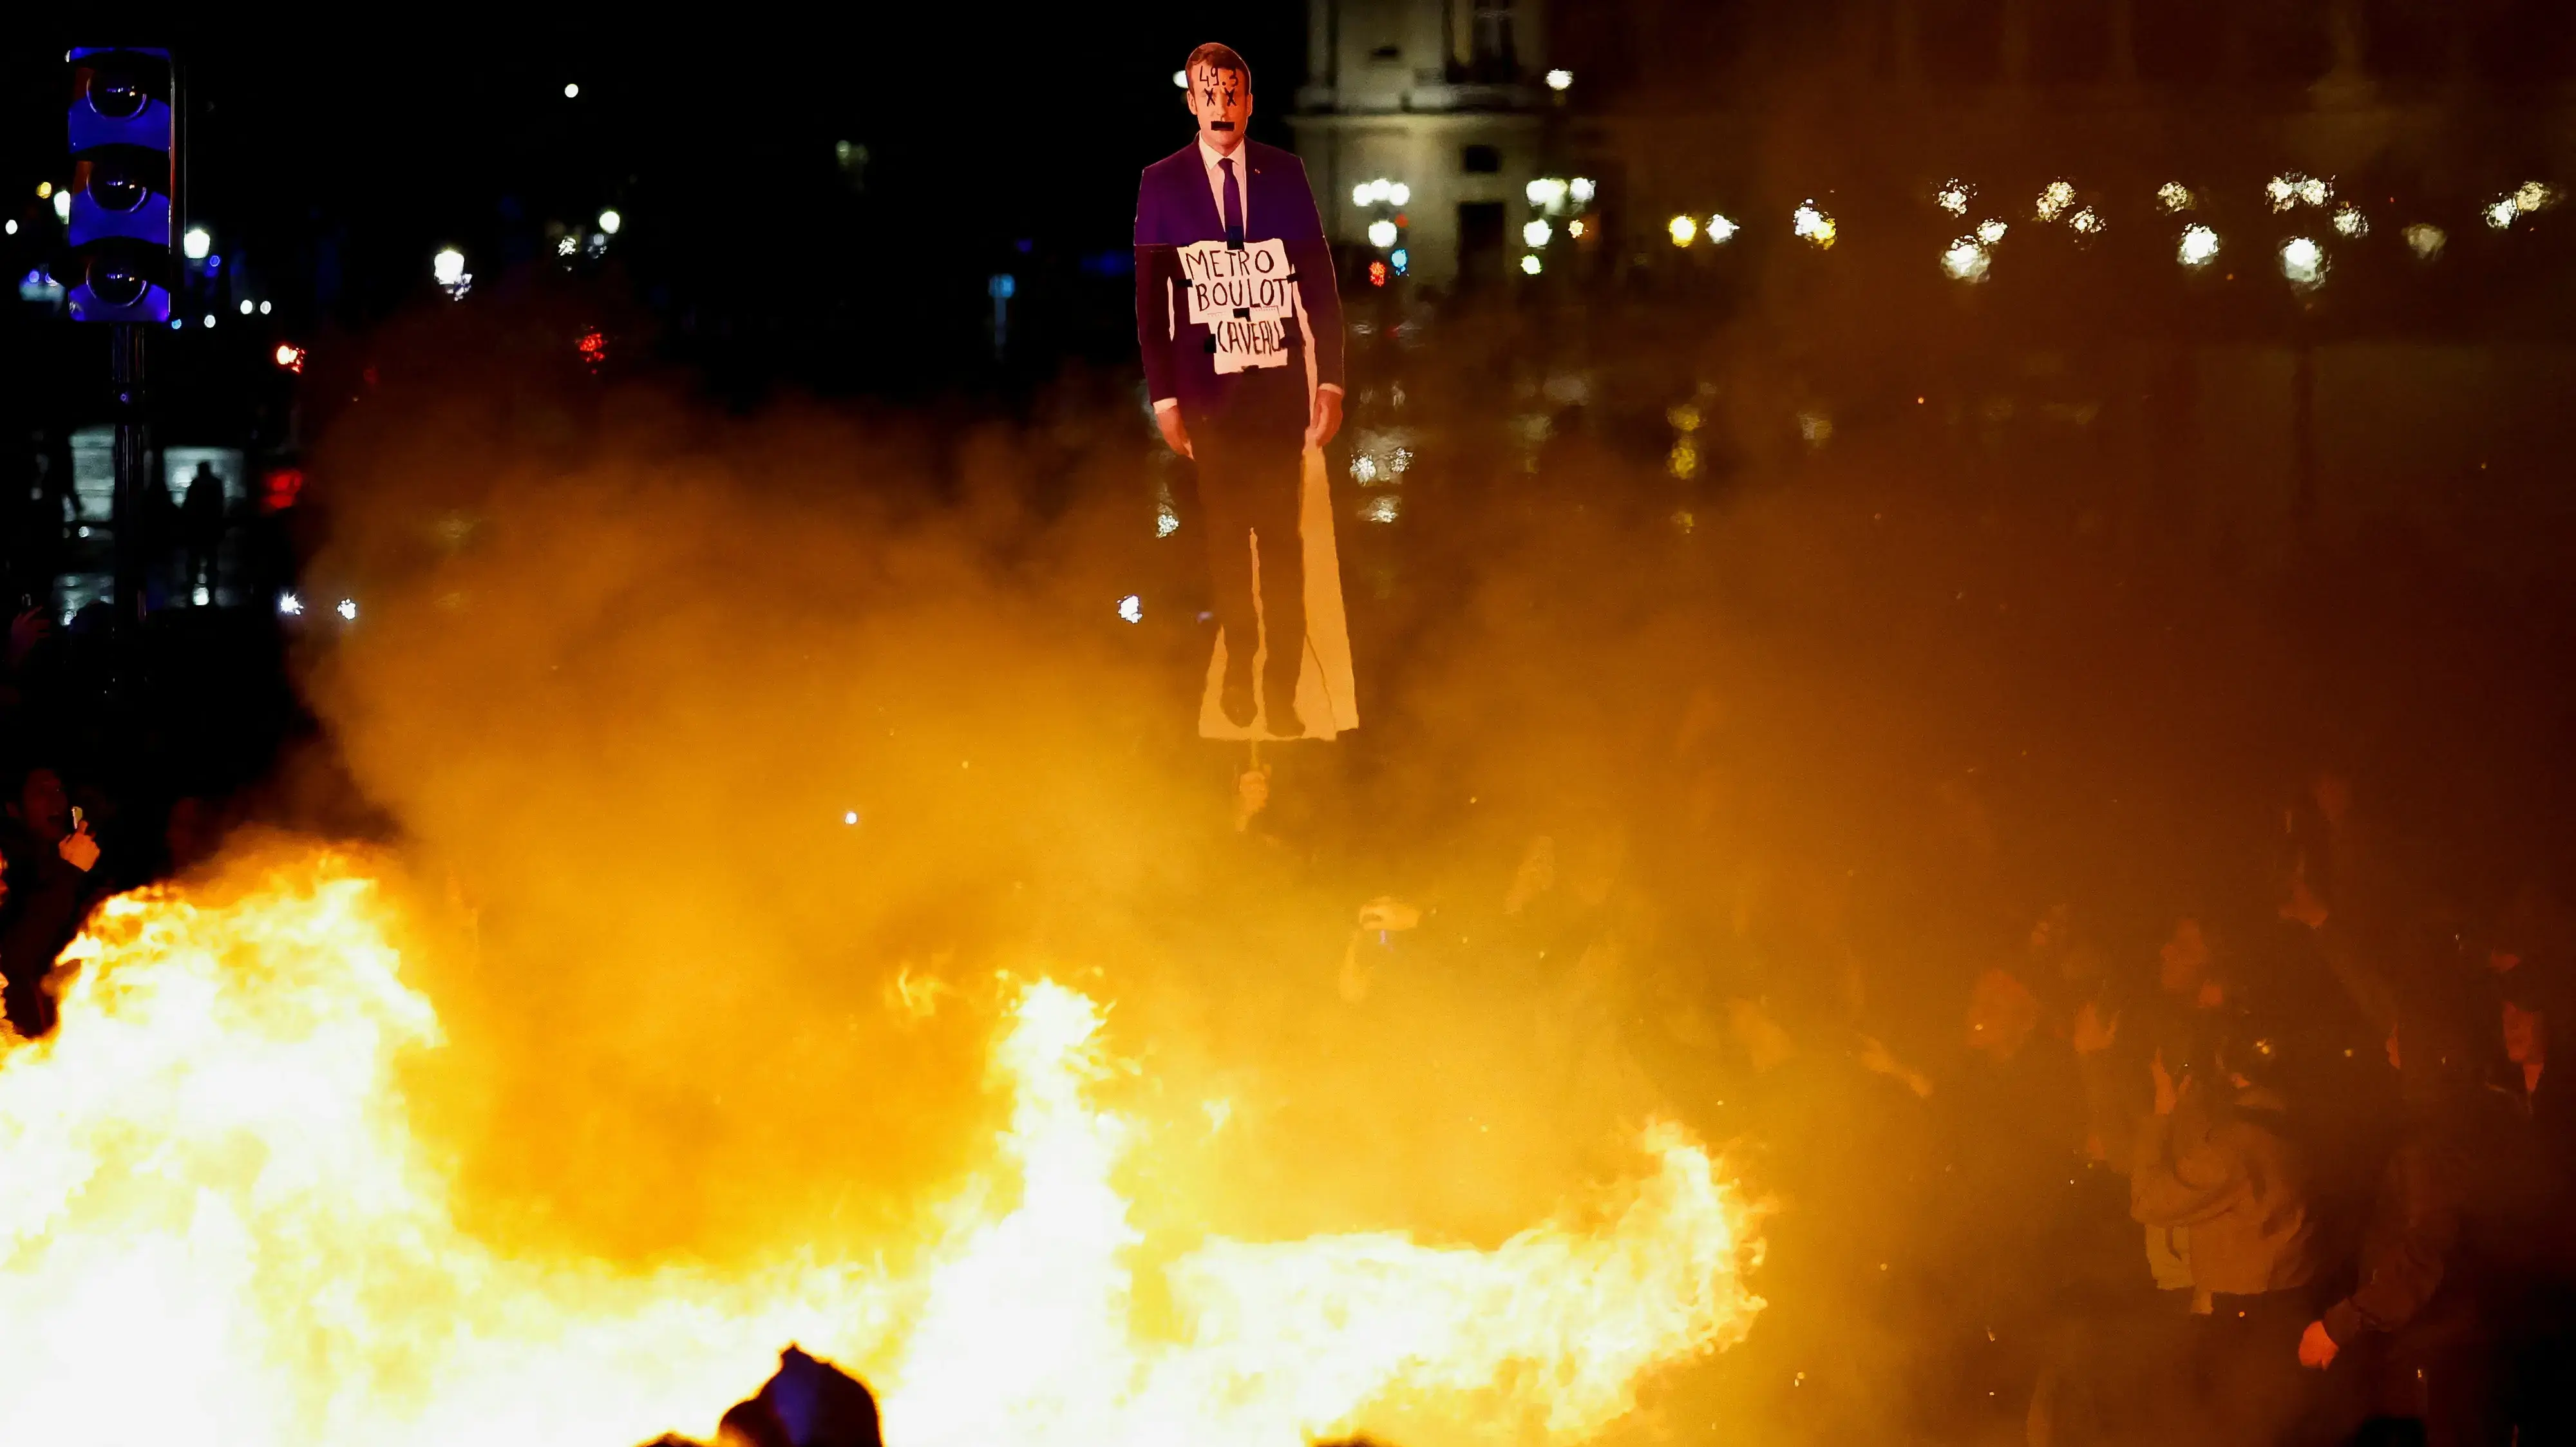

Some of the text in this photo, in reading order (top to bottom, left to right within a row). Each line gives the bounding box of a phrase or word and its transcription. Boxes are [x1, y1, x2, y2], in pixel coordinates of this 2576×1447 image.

[1185, 249, 1274, 280] METRO
[1195, 278, 1287, 312] BOULOT
[1217, 320, 1282, 355] CAVEAU
